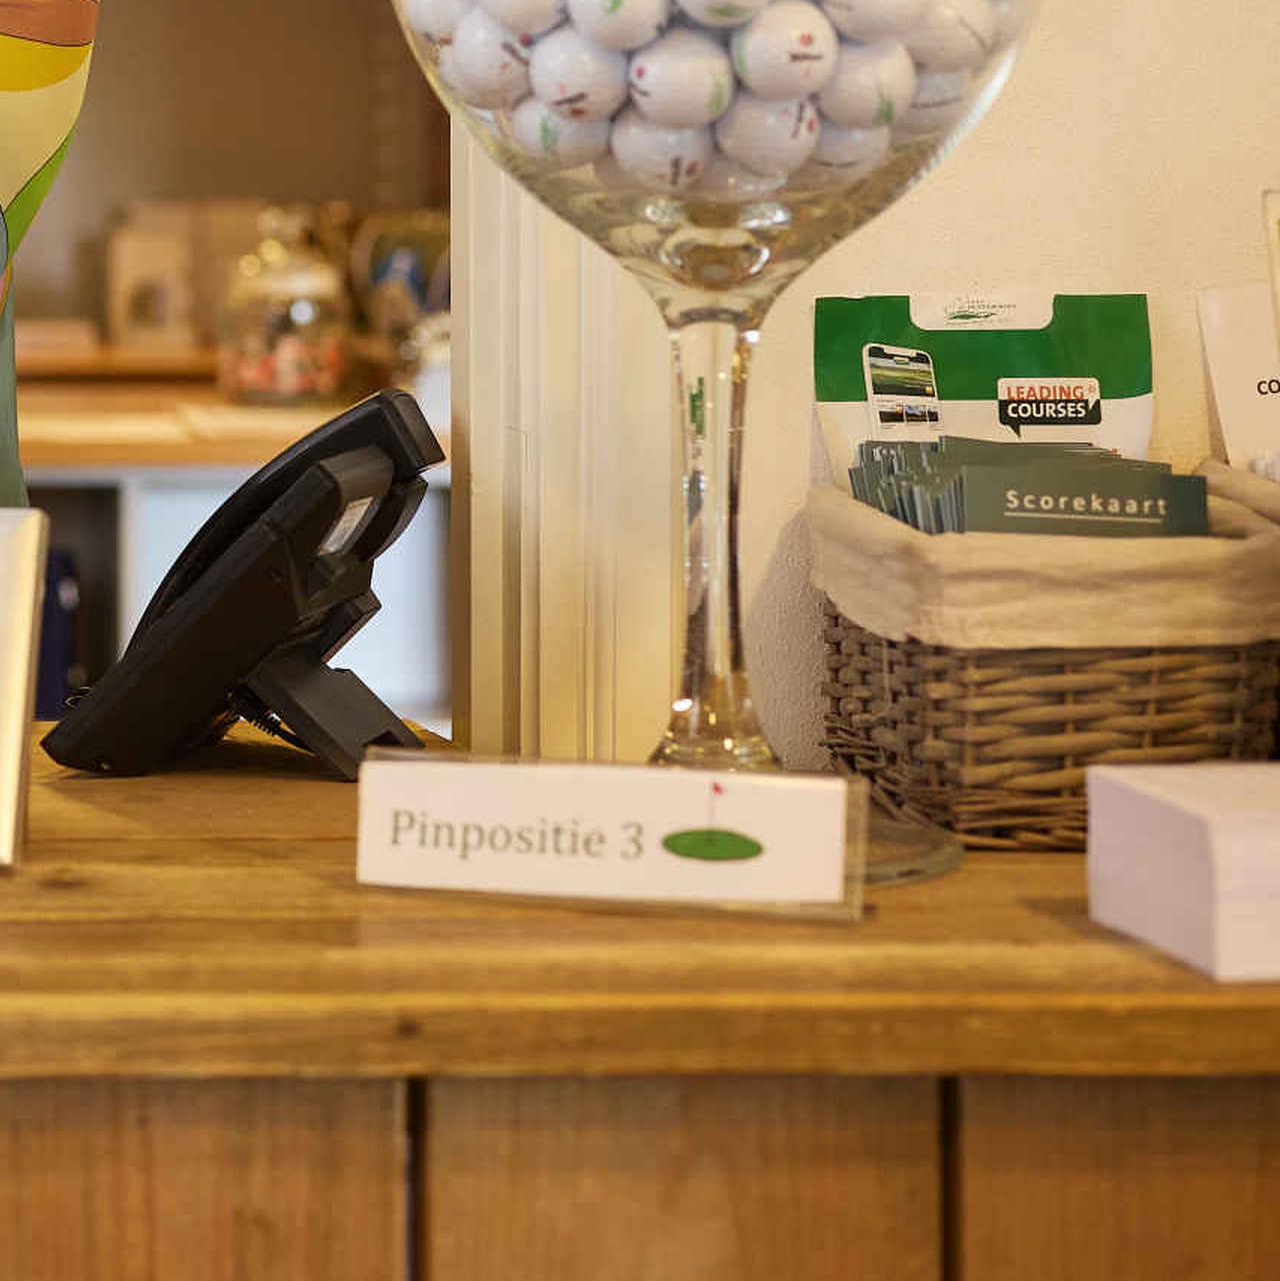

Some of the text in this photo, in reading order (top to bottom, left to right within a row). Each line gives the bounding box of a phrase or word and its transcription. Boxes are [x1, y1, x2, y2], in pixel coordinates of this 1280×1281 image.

[1006, 385, 1084, 401] LEADING
[1007, 402, 1086, 418] COURSES
[1005, 489, 1168, 515] Scorekaart
[390, 809, 644, 861] Pinpositie 3
